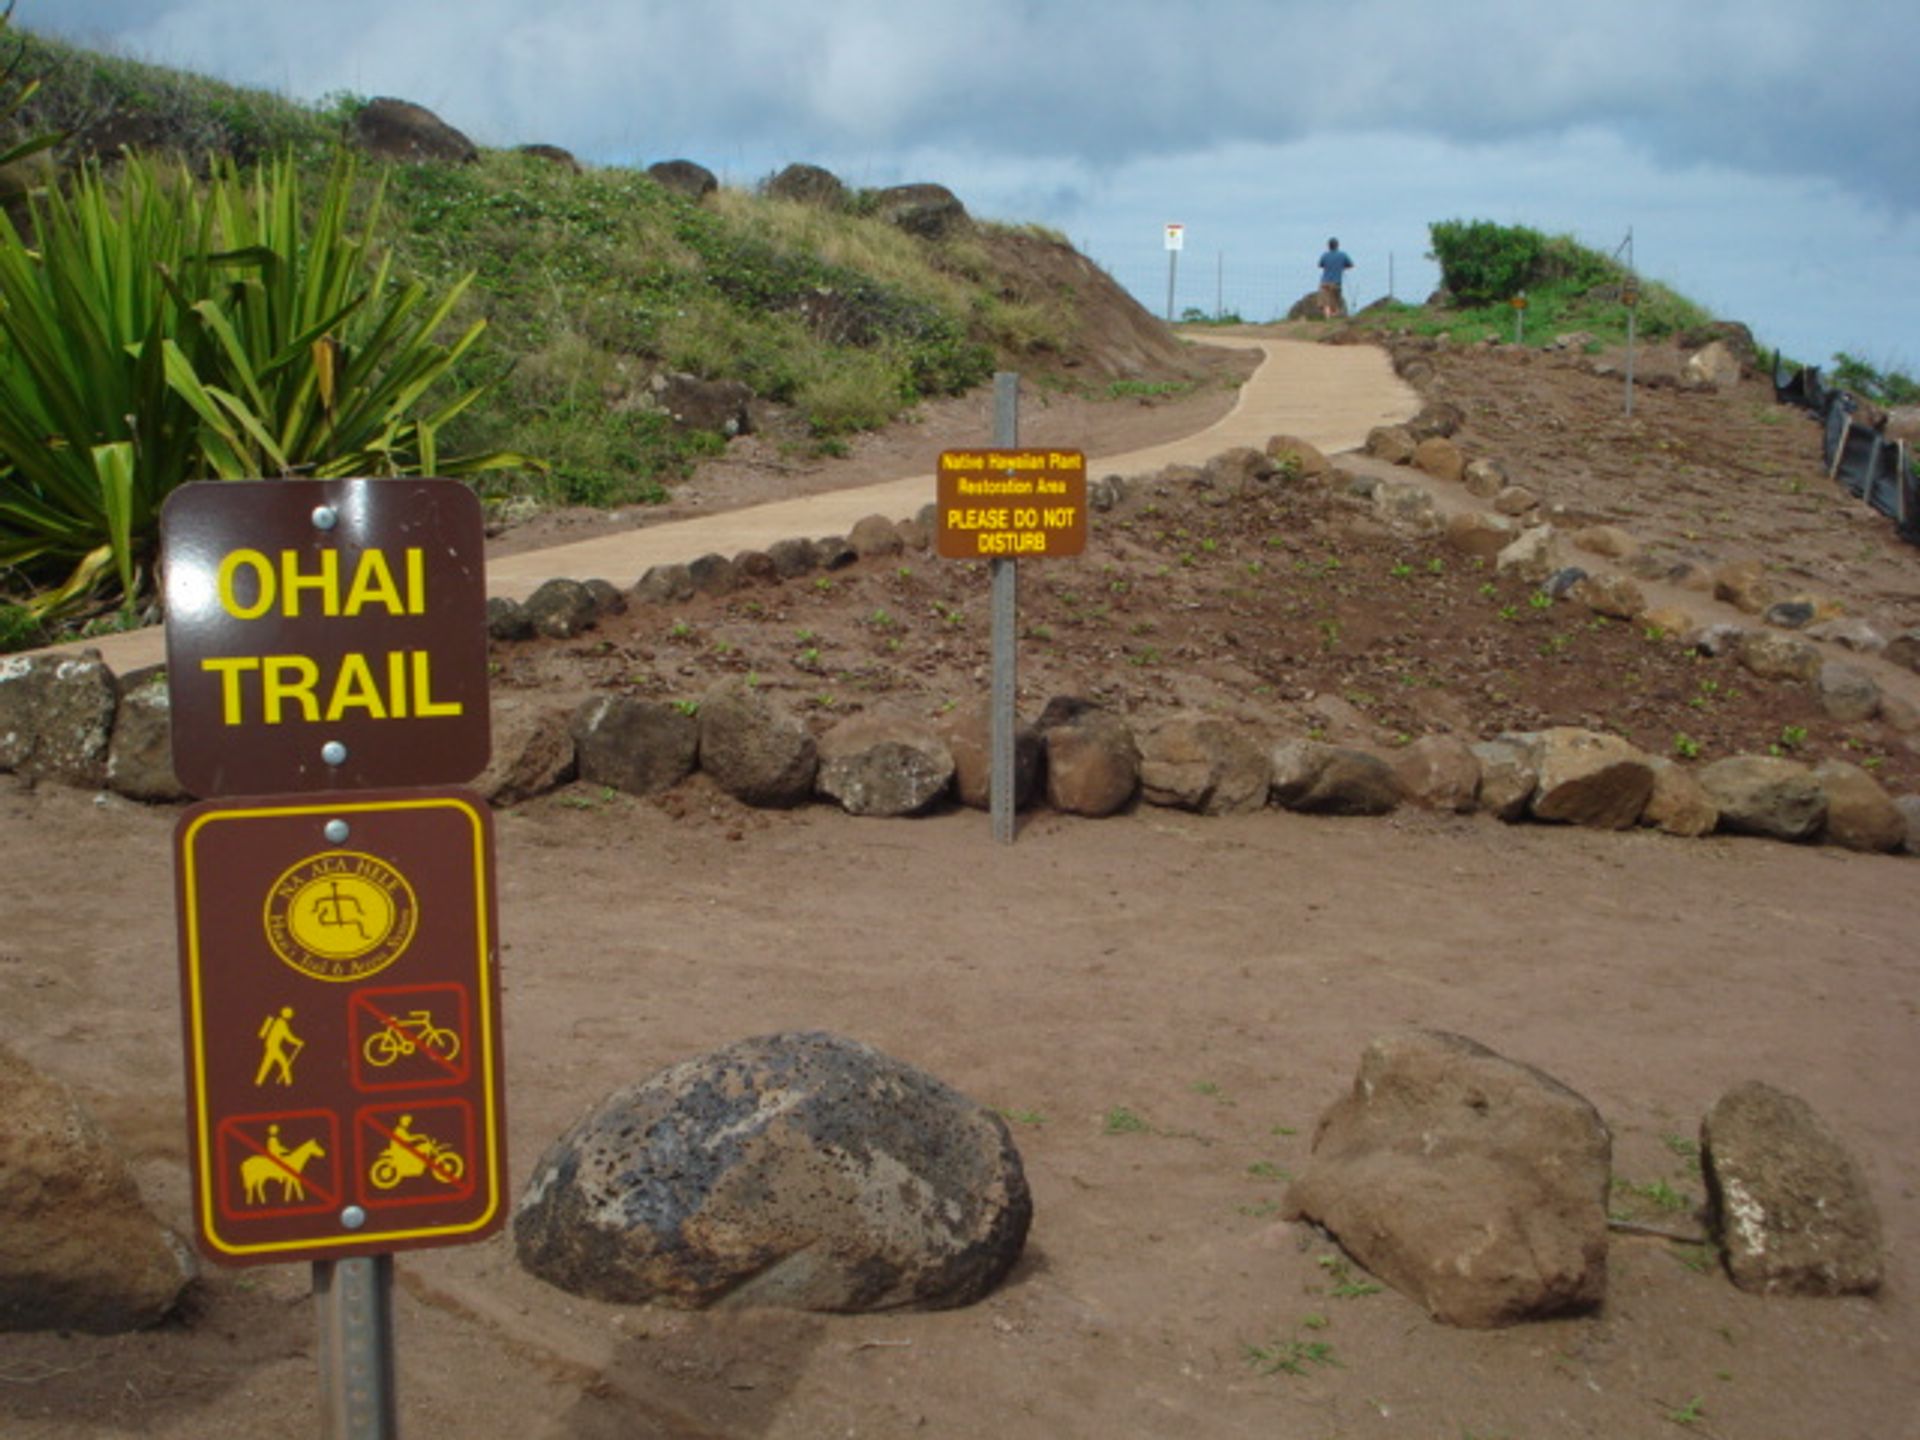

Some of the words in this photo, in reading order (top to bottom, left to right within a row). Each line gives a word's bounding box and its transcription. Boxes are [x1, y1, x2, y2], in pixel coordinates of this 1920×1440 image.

[958, 477, 1033, 494] Restoration
[1036, 477, 1067, 494] Area
[948, 508, 1009, 529] PLEASE
[1014, 507, 1039, 528] DO
[1043, 507, 1076, 527] NOT
[978, 531, 1046, 552] DISTURB
[217, 547, 425, 619] OHAI
[201, 650, 463, 725] TRAIL
